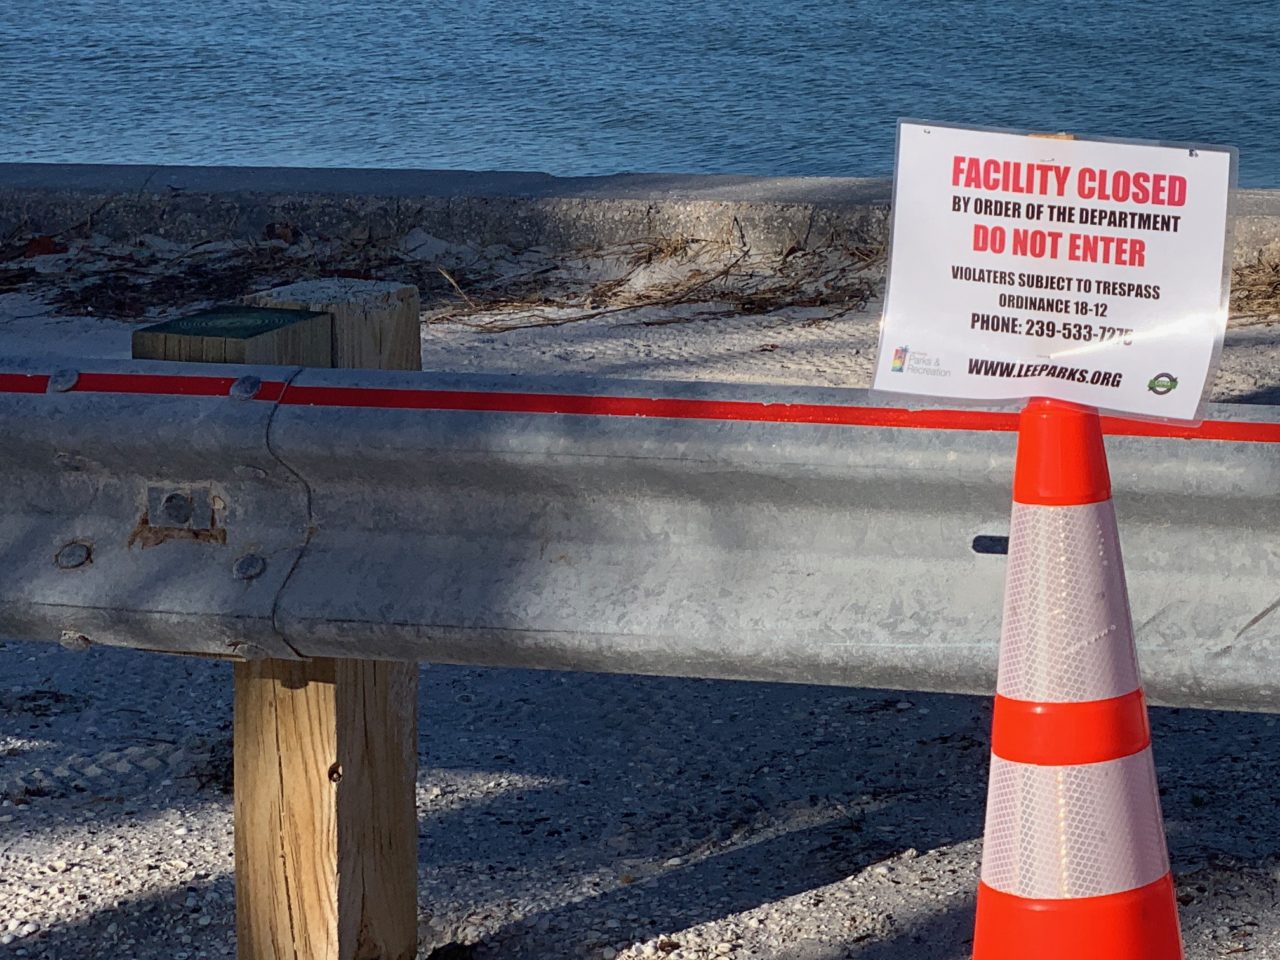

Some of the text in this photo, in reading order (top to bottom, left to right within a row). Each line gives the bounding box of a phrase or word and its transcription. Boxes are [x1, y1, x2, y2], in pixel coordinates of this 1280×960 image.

[951, 155, 1188, 207] FACILITY CLOSED
[952, 195, 1181, 233] BY ORDER OF THE DEPARTMENT
[972, 224, 1146, 268] DO NOT ENTER
[951, 265, 1161, 300] VIOLATERS SUBJECT TO TRESPASS
[998, 293, 1108, 318] ORDINANCE 18-12
[970, 313, 1022, 336] PHONE:
[908, 354, 933, 366] Parks
[968, 357, 1123, 388] WWW.LEEPARKS.ORG
